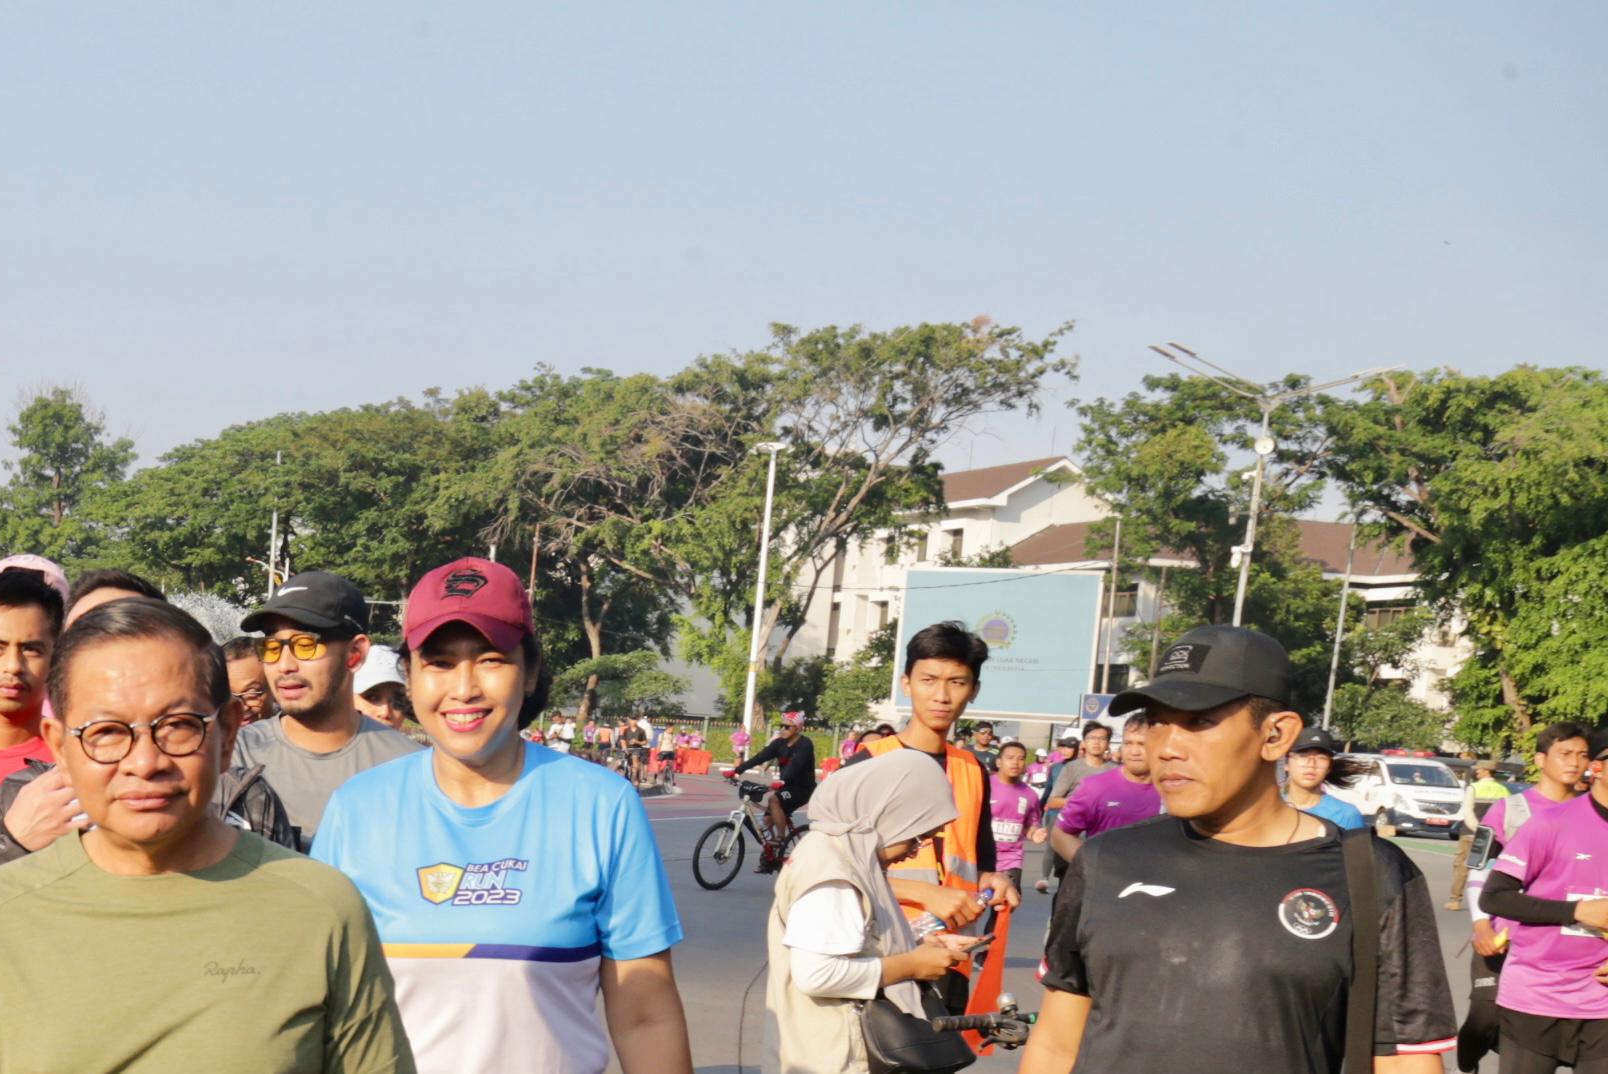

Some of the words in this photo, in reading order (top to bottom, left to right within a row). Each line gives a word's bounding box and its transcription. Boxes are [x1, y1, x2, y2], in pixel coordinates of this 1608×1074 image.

[466, 863, 489, 872] BEA
[492, 859, 528, 871] CUKAI
[459, 870, 507, 890] RUN
[453, 889, 521, 905] 2023
